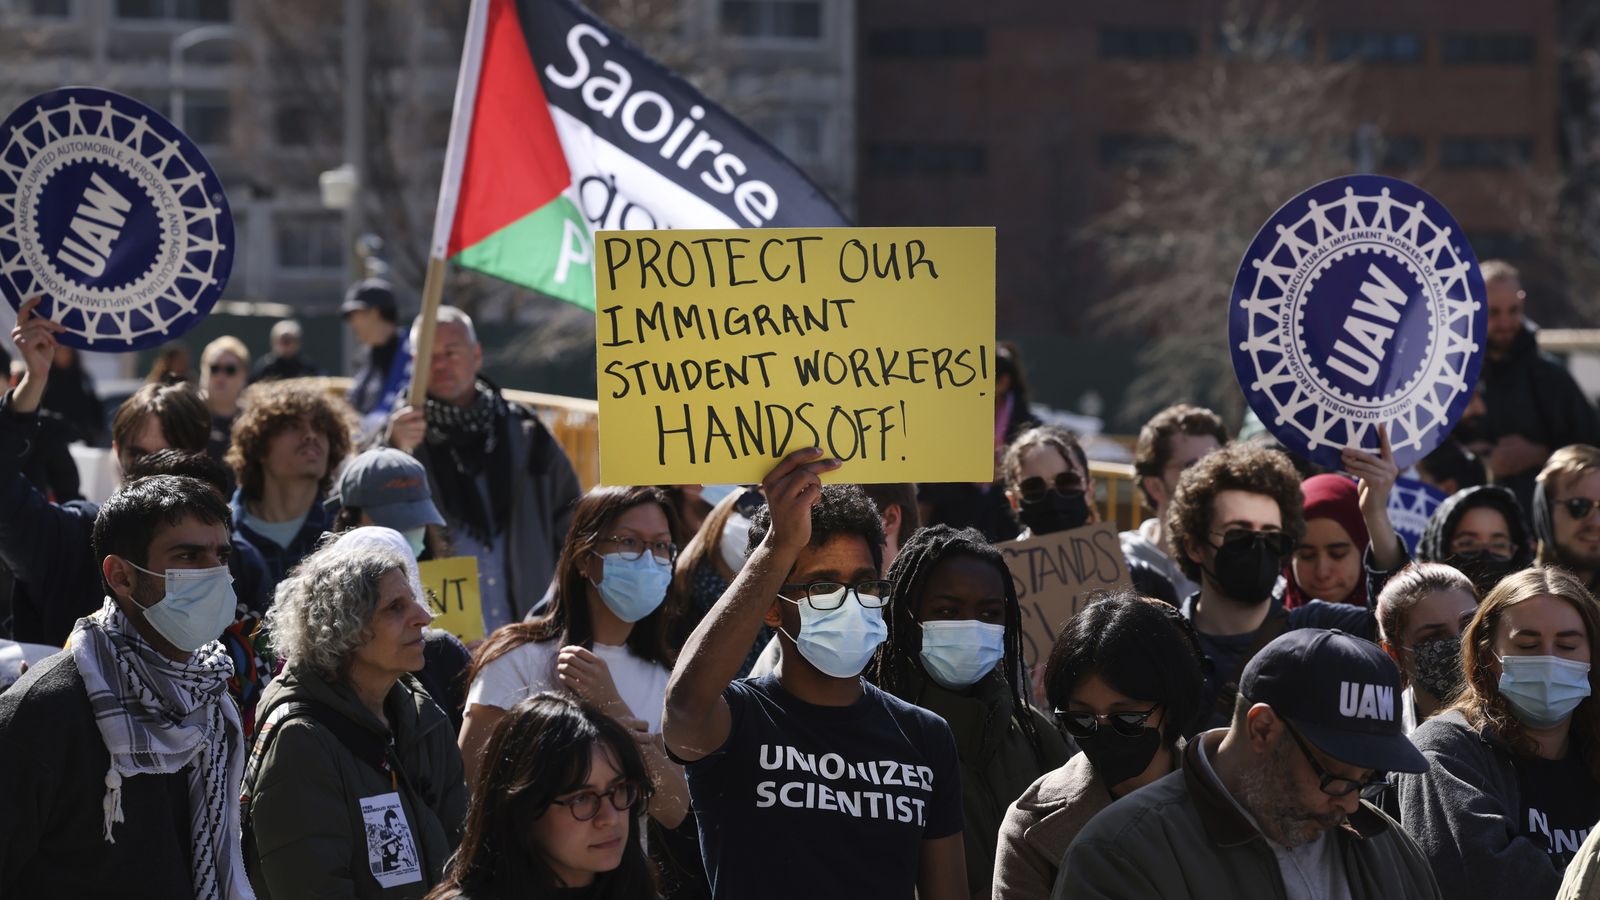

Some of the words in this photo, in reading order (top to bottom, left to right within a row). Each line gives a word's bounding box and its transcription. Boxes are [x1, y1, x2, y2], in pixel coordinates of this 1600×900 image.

[544, 23, 778, 228] Saoirse
[28, 151, 56, 183] UNITED
[127, 158, 175, 210] AEROSPACE
[19, 184, 32, 233] AMERICA
[57, 172, 132, 278] UAW
[167, 212, 181, 237] AND
[22, 236, 33, 251] OF
[604, 236, 823, 290] PROTECT
[839, 239, 939, 283] OUR
[1330, 231, 1382, 248] IMPLEMENT
[1387, 234, 1424, 264] WORKERS
[28, 252, 67, 297] WORKERS
[134, 238, 181, 300] AGRICULTURAL
[1284, 245, 1329, 310] AGRICULTURAL
[1424, 265, 1434, 277] OF
[69, 293, 134, 308] IMPLEMENT
[602, 298, 855, 347] IMMIGRANT
[1282, 313, 1290, 336] AND
[1326, 263, 1408, 386] UAW
[1432, 282, 1447, 326] AMERICA
[604, 352, 777, 399] STUDENT
[794, 345, 988, 397] WORKERS!
[1284, 342, 1317, 394] AEROSPACE
[1383, 398, 1413, 417] UNITED
[655, 400, 821, 466] HANDS
[827, 399, 907, 462] OFF!
[1339, 681, 1394, 722] UAW
[759, 744, 934, 792] UNIONIZED
